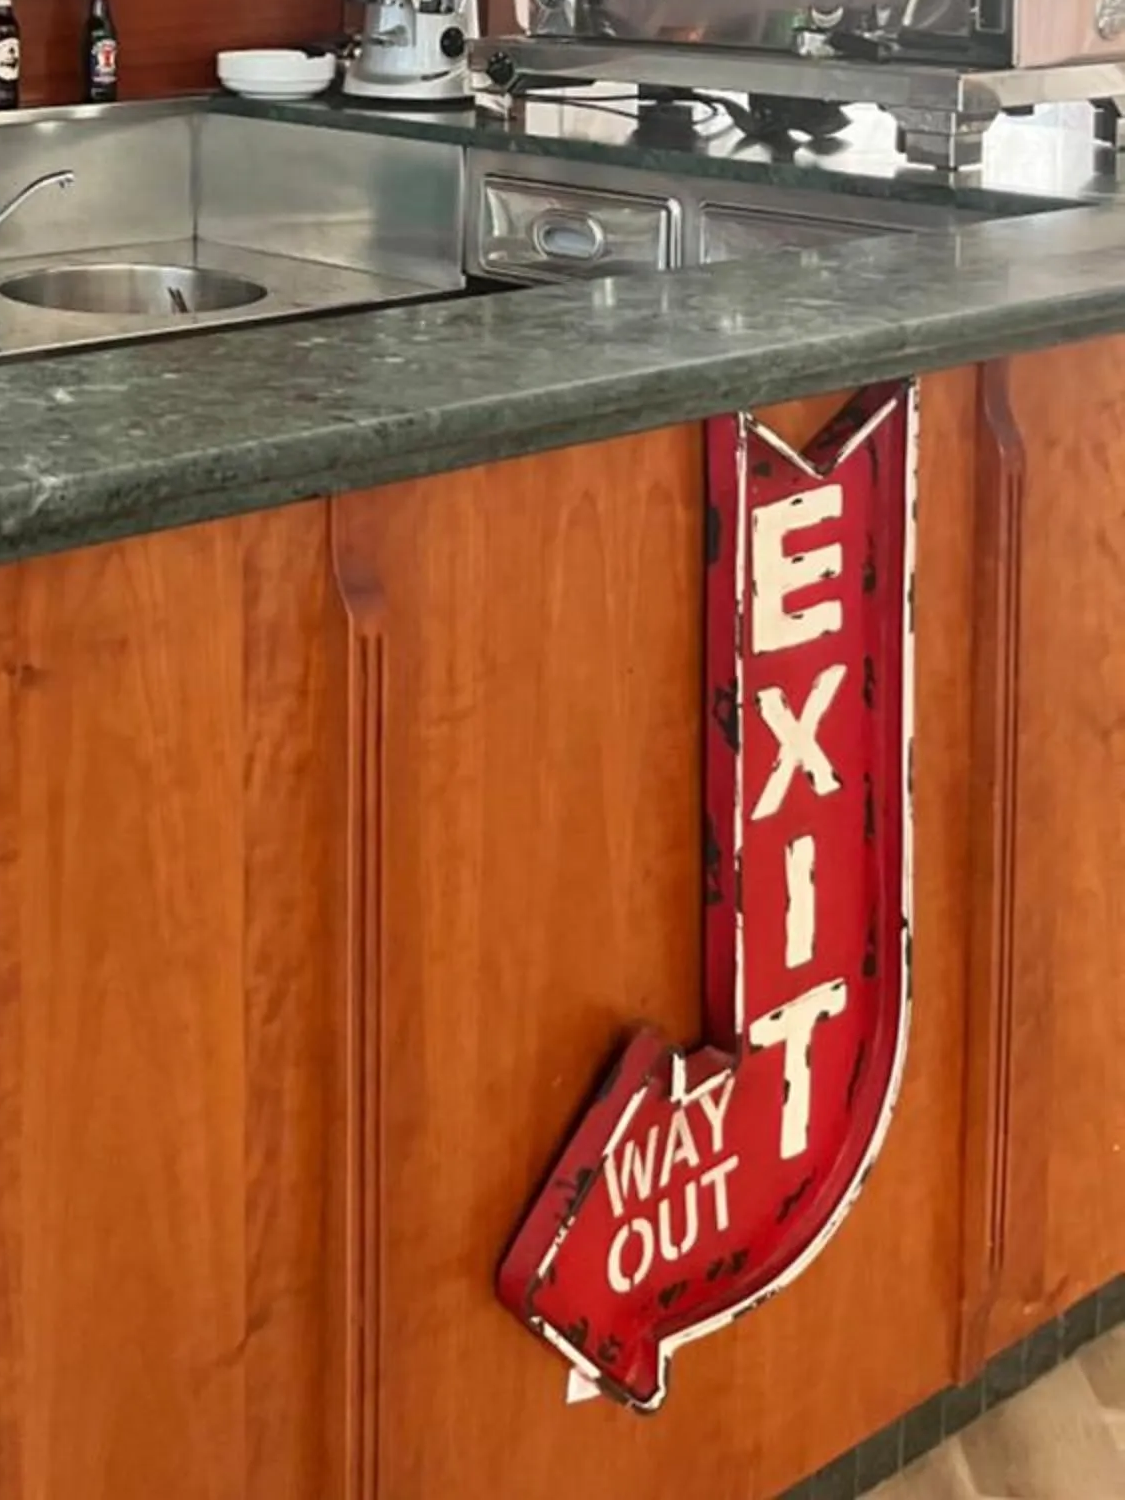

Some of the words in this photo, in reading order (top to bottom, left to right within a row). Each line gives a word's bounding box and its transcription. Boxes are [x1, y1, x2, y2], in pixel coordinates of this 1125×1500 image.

[750, 483, 848, 1159] EXIT
[603, 1076, 736, 1218] WAY
[607, 1155, 740, 1293] OUT
